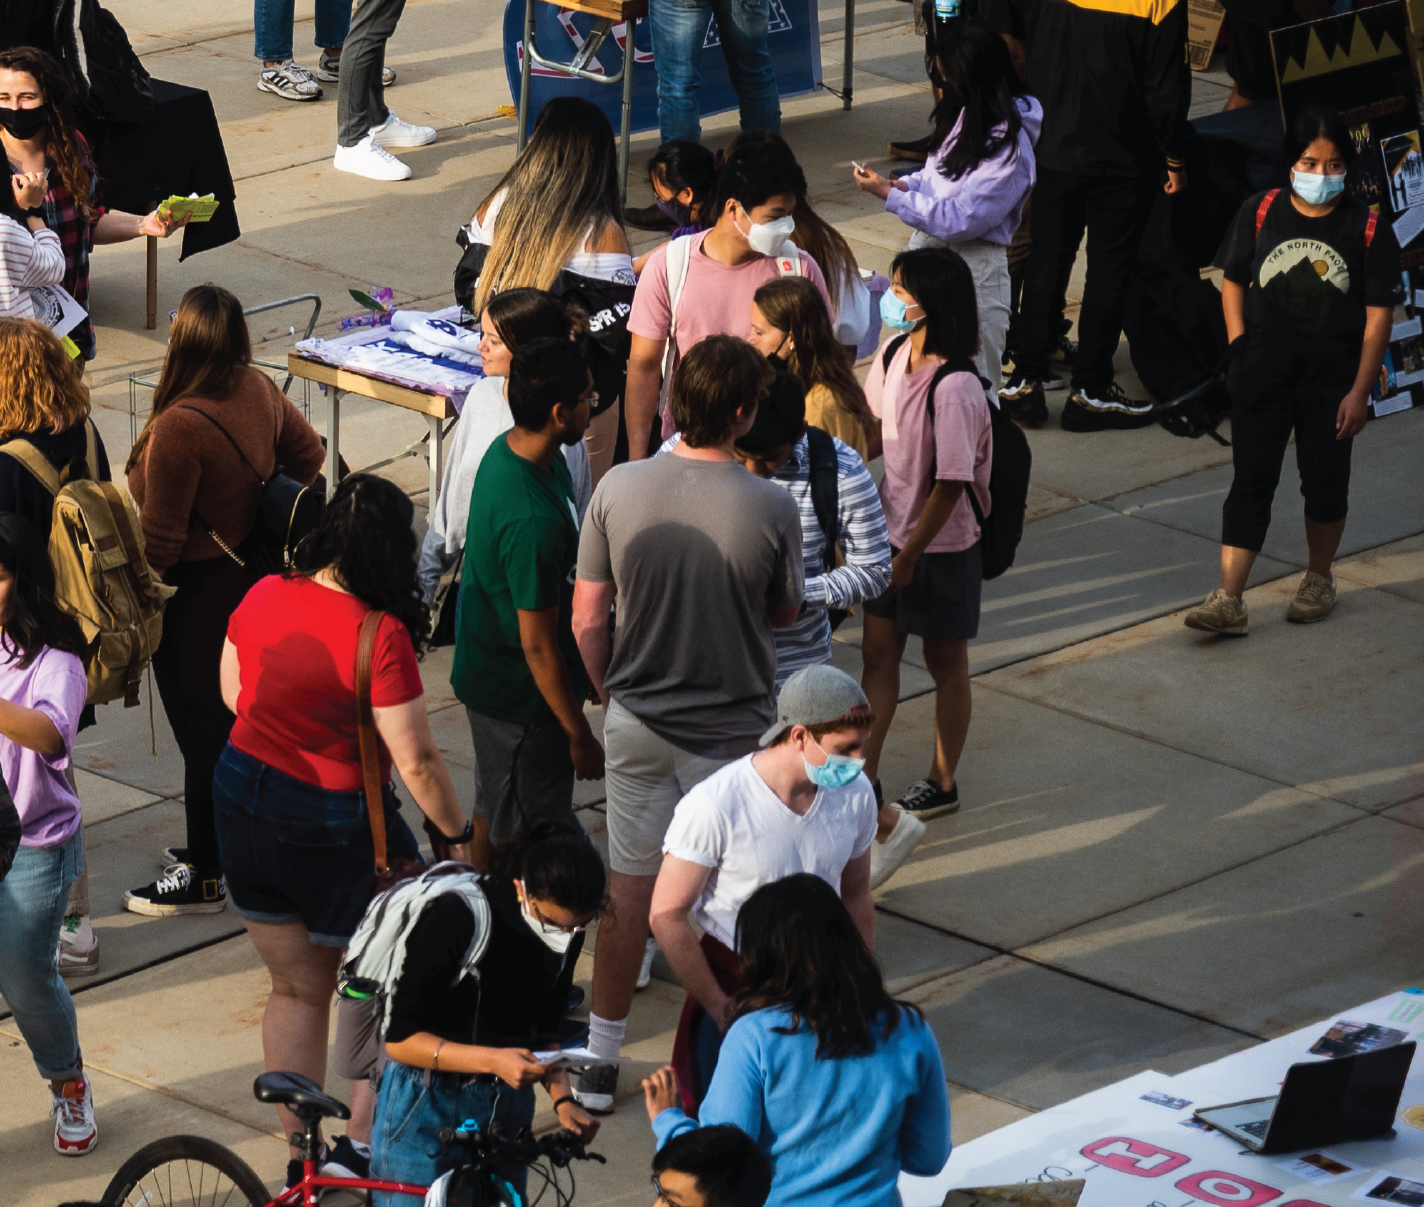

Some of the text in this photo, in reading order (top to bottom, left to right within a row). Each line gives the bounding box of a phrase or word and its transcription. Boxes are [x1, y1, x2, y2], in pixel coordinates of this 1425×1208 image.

[1266, 241, 1347, 273] THE NORTH FACE
